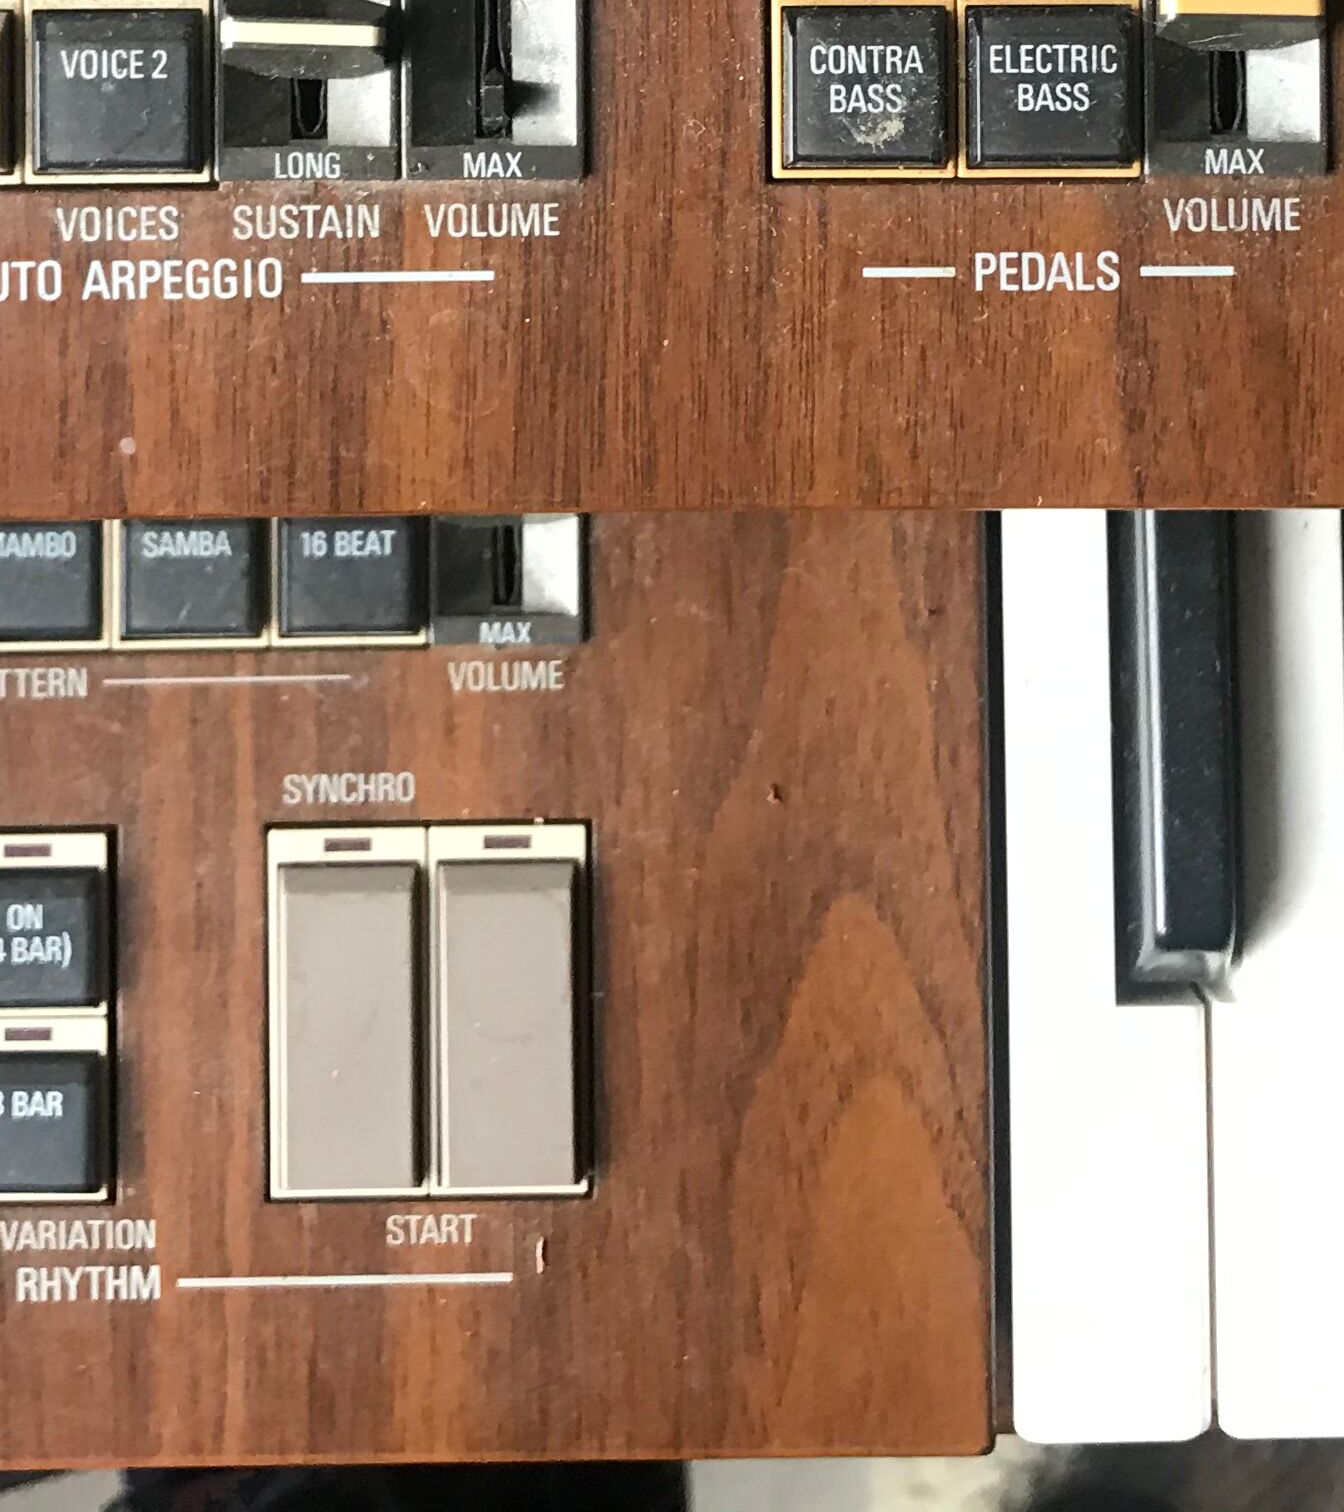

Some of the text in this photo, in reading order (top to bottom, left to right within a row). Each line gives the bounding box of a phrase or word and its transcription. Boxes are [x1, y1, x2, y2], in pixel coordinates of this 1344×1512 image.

[59, 49, 168, 80] VOICE 2
[809, 45, 924, 75] CONTRA
[989, 43, 1118, 74] ELECTRIC
[829, 83, 903, 114] BASS
[1017, 82, 1090, 112] BASS
[274, 151, 341, 179] LONG
[463, 151, 523, 178] MAX
[1204, 148, 1265, 175] MAX
[55, 205, 179, 243] VOICES
[232, 203, 380, 241] SUSTAIN
[423, 202, 560, 238] VOLUME
[1162, 197, 1301, 233] VOLUME
[81, 257, 283, 301] ARPEGGIO
[974, 250, 1120, 292] PEDALS
[140, 530, 232, 559] SAMBA
[300, 529, 397, 559] 16 BEAT
[479, 621, 532, 649] MAX
[447, 659, 564, 693] VOLUME
[282, 771, 416, 805] SYNCHRO
[6, 903, 43, 932] ON
[11, 1090, 63, 1119] BAR
[386, 1213, 478, 1246] START
[16, 1264, 161, 1303] RHYTHM
